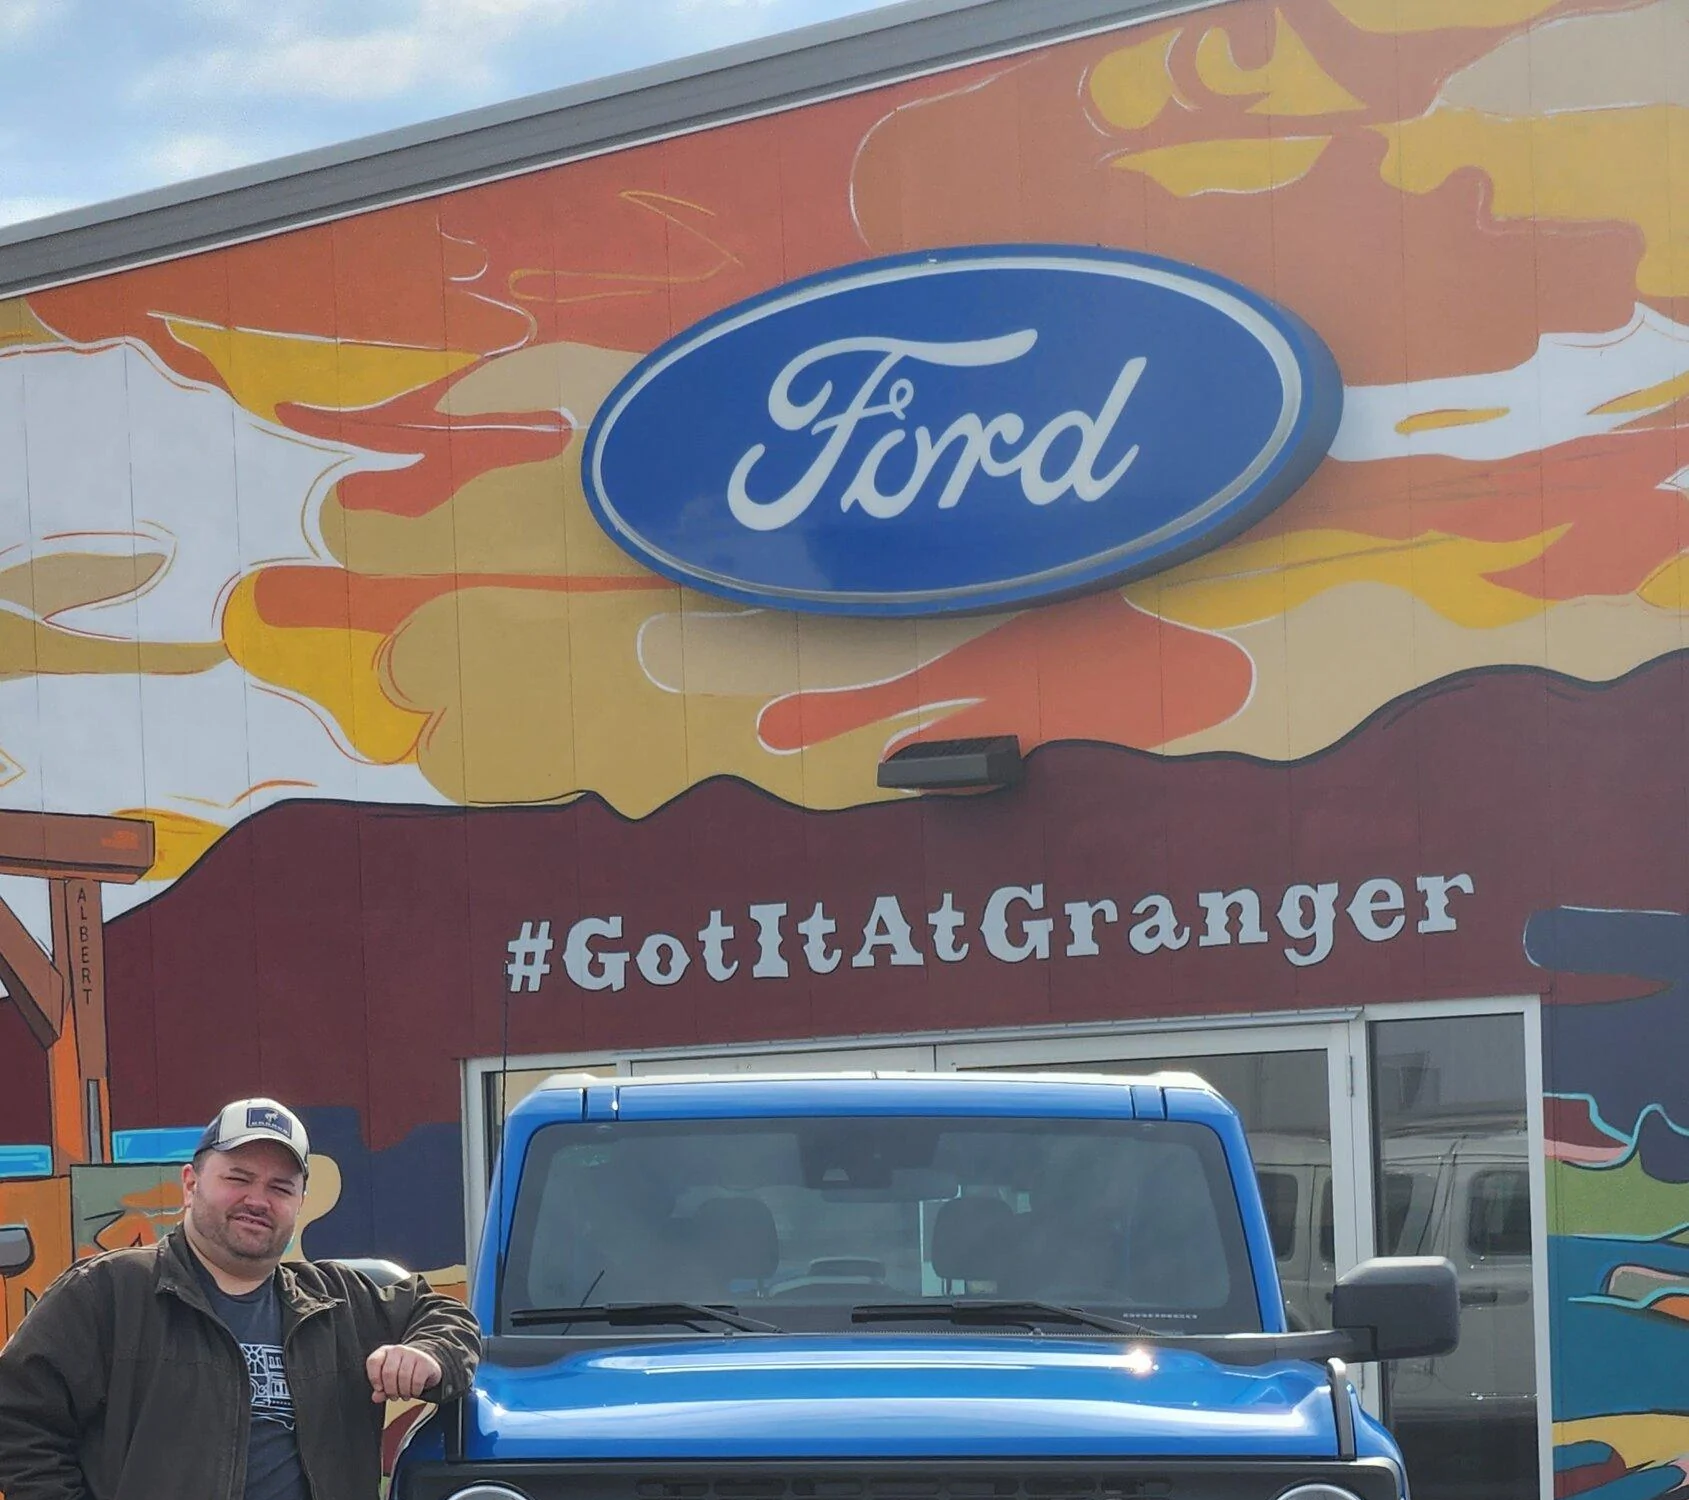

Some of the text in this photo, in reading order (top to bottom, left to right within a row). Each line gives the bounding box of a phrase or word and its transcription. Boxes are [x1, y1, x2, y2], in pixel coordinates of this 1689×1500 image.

[727, 328, 1147, 531] Ford
[77, 887, 92, 1005] ALBERT
[507, 872, 1475, 992] #GotItAtGranger
